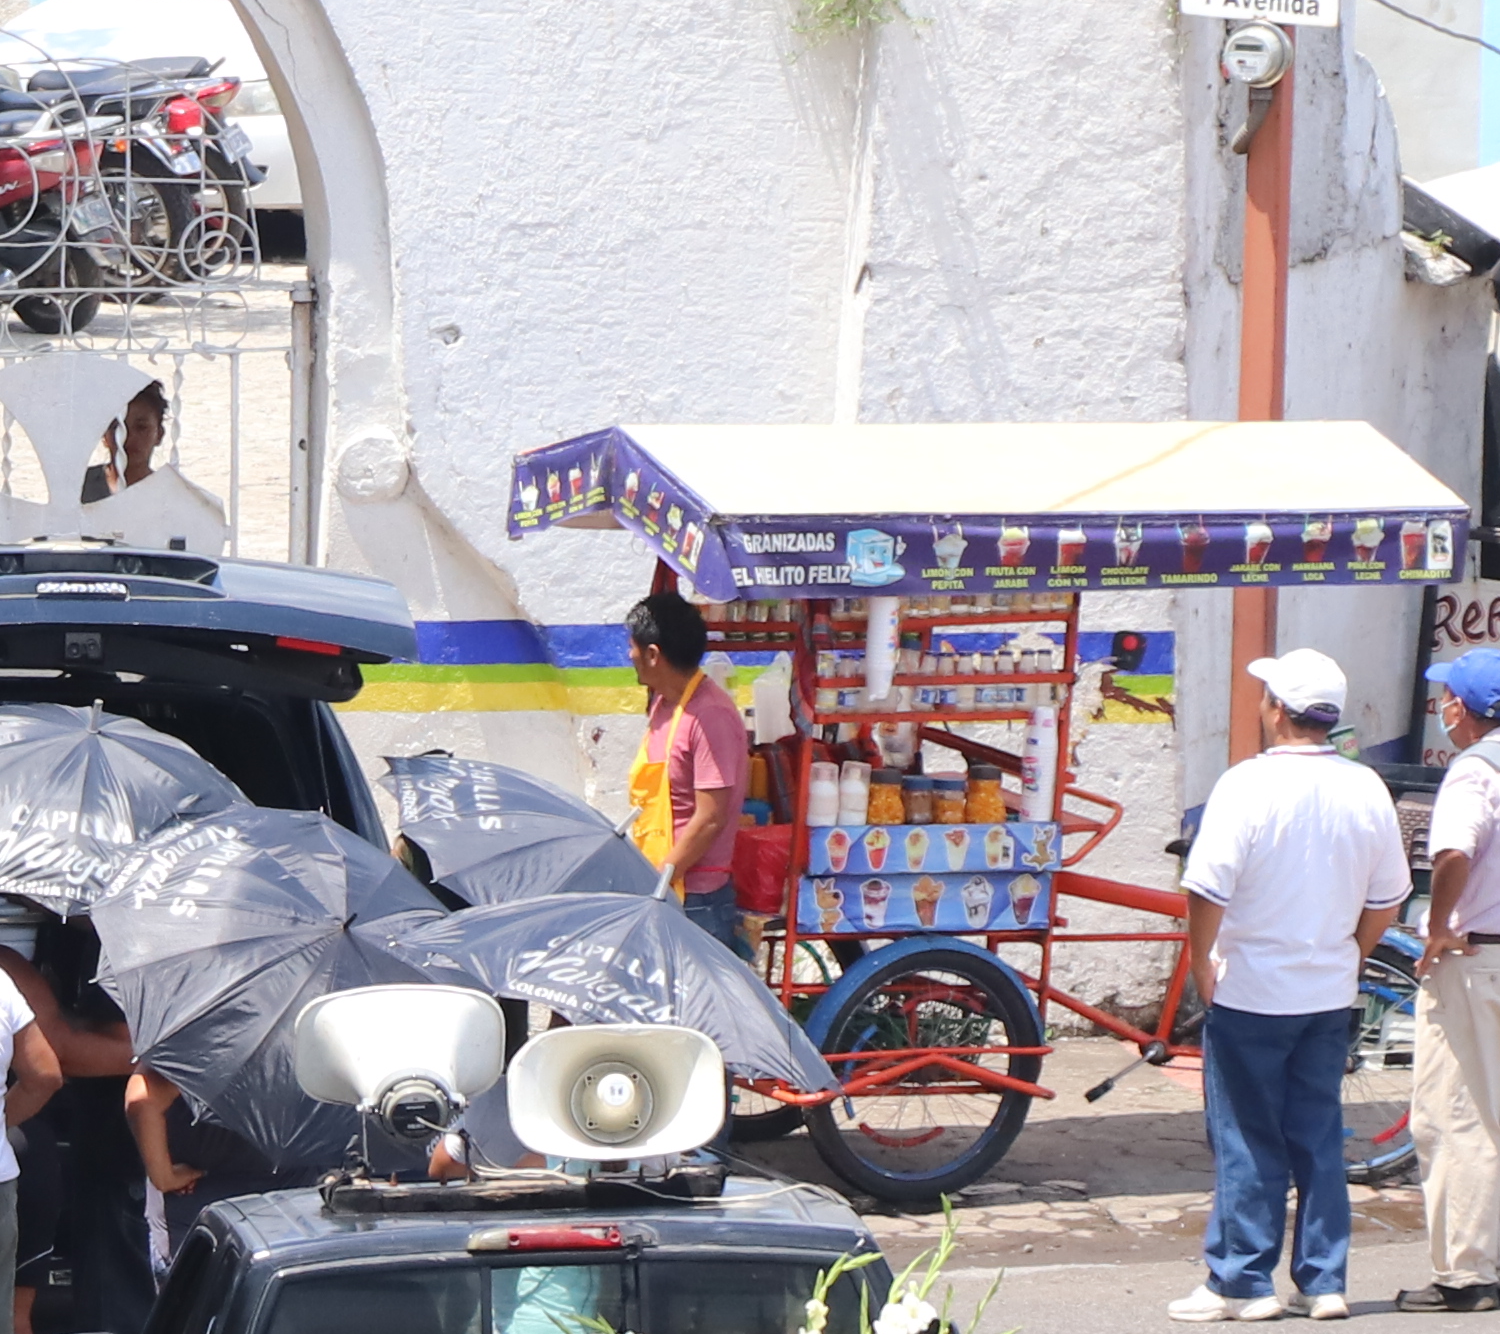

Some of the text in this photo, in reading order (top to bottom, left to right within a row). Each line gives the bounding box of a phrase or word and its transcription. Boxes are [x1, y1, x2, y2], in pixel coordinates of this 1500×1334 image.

[743, 533, 836, 554] GRANIZADAS
[732, 565, 852, 587] EL HELITO FELIZ
[1160, 573, 1218, 584] TAMARINDO
